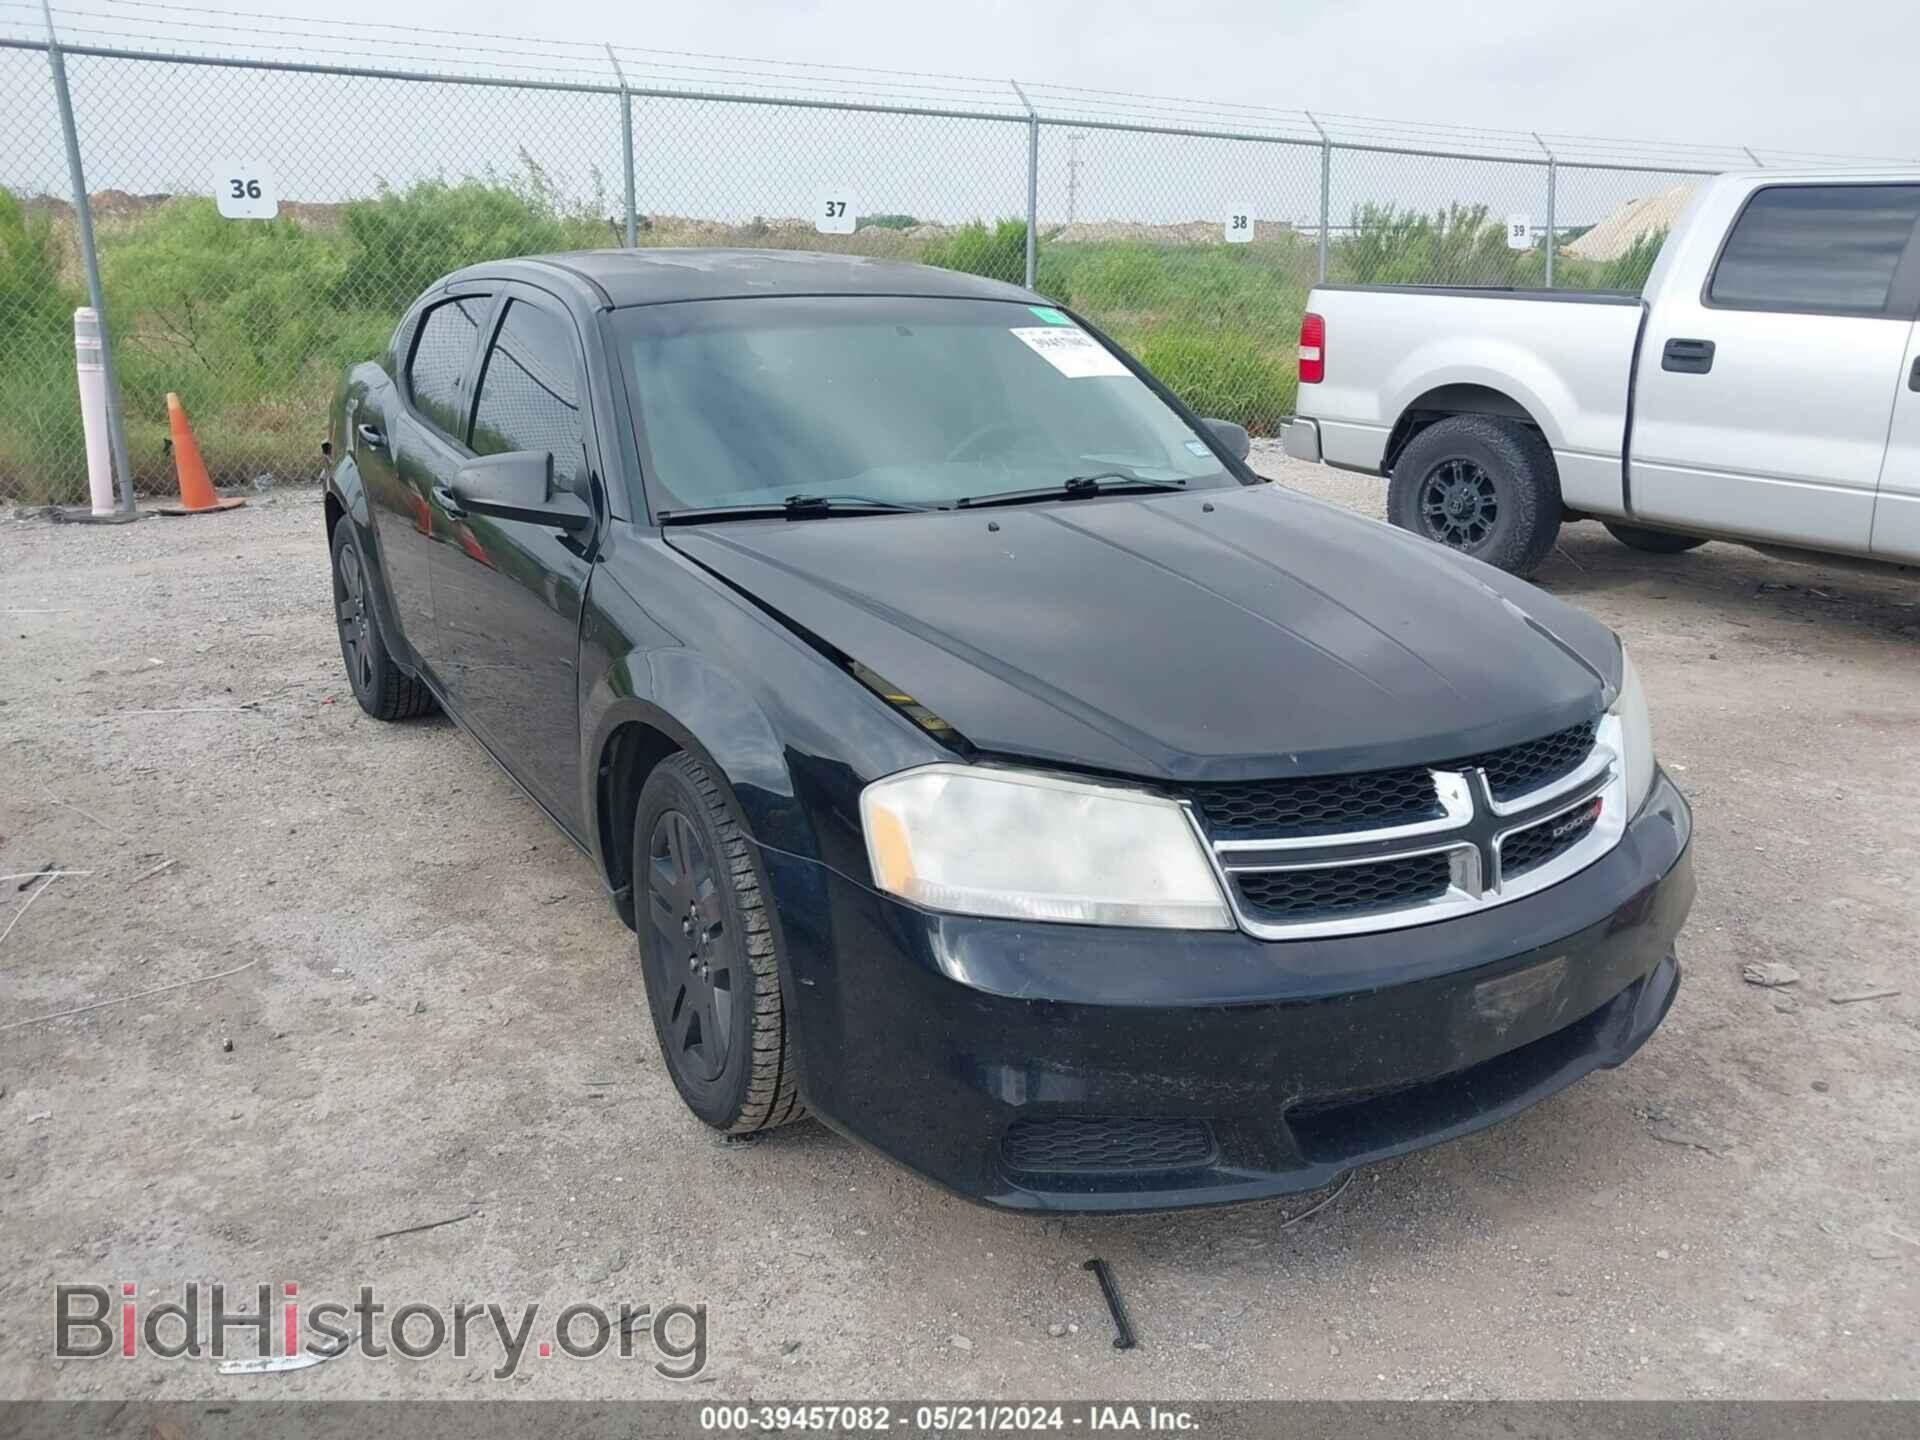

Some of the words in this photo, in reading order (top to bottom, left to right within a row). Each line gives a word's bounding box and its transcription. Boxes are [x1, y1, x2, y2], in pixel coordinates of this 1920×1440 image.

[230, 179, 262, 199] 36
[825, 201, 847, 217] 37
[1232, 215, 1248, 229] 38
[1513, 224, 1525, 237] 39
